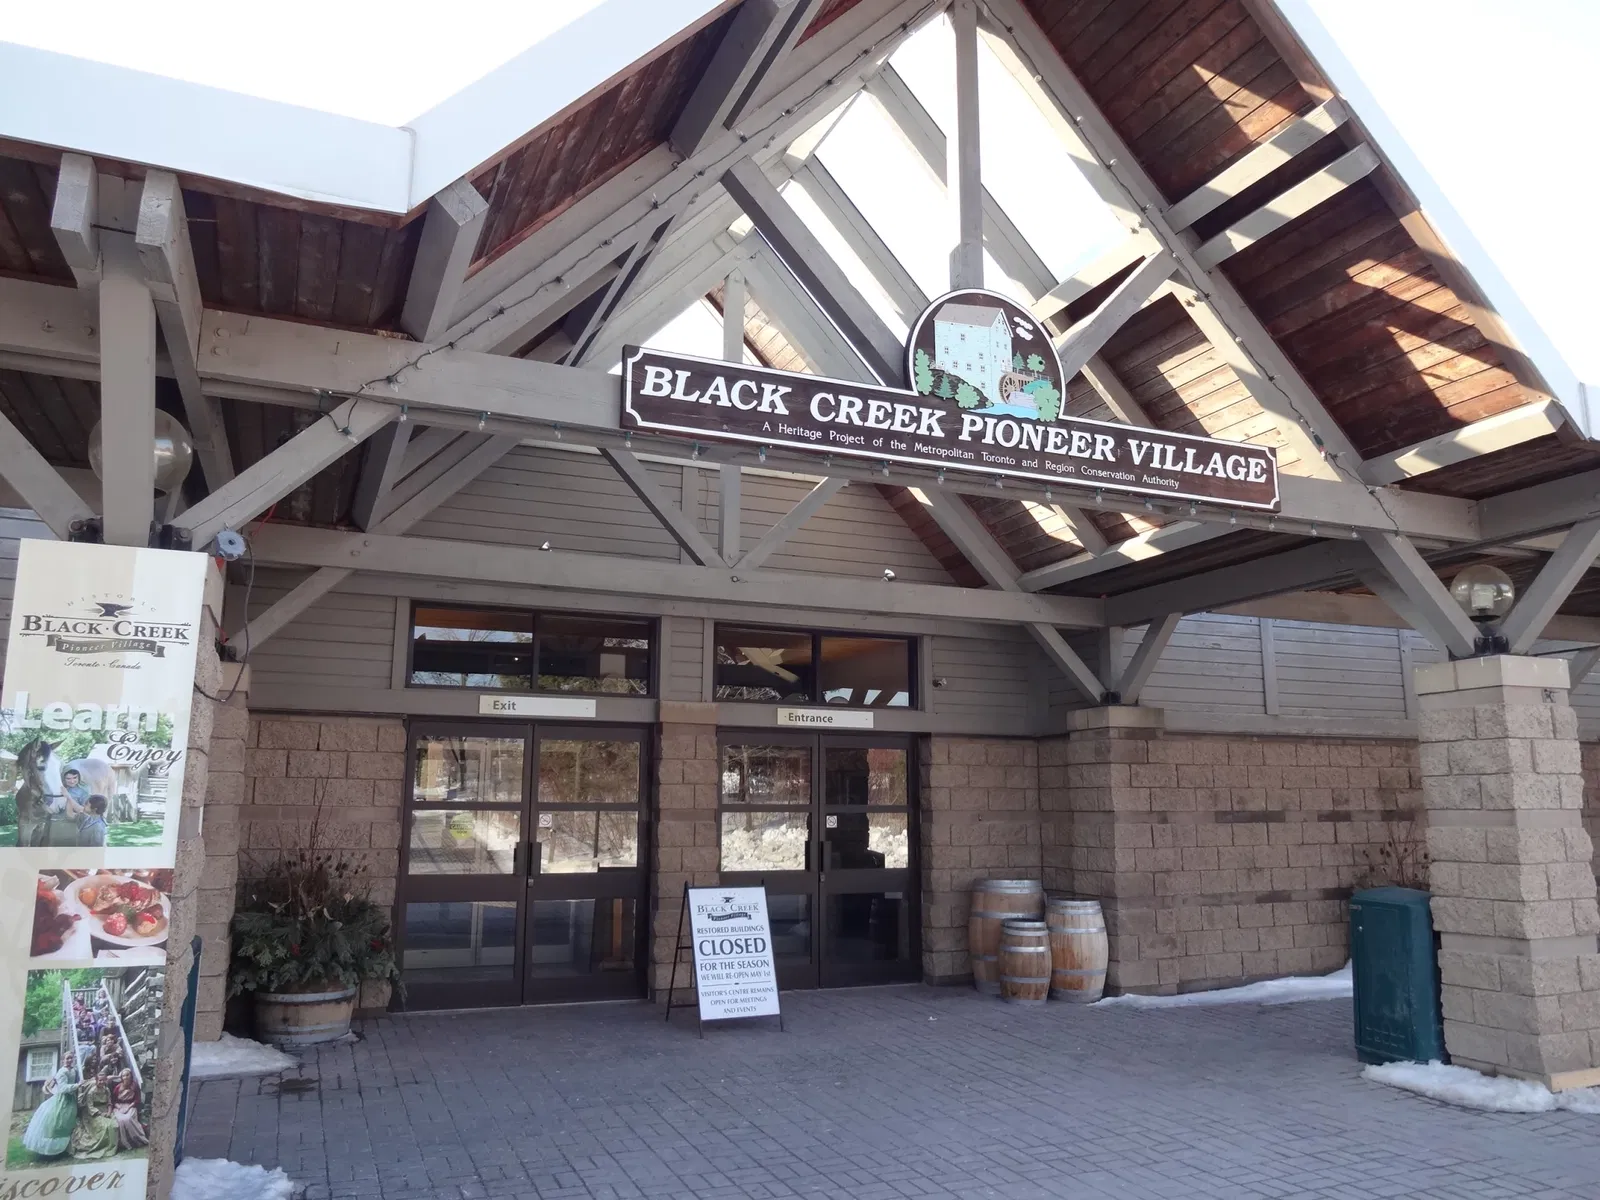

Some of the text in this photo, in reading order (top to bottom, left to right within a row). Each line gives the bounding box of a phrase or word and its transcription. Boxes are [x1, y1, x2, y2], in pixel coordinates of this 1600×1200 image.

[640, 365, 1267, 483] BLACK CREEK PIONEER VILLAGE
[762, 421, 1180, 490] A Heritage Project of the Metropolitan Toronto and Region Conservation Authority
[21, 614, 190, 641] BLACK CREEK
[62, 639, 152, 653] Pioneer Village
[63, 656, 142, 671] Toronto Canada
[14, 690, 159, 732] Learn
[492, 700, 517, 711] Exit
[788, 712, 833, 724] Entrance
[107, 730, 182, 774] Enjoy
[697, 903, 759, 913] BLACK CREEK
[696, 924, 765, 935] RESTORED BUILDINGS
[699, 937, 766, 956] CLOSED
[700, 959, 770, 971] FOR THE SEASON
[725, 971, 749, 980] RE-OPEN
[750, 970, 762, 978] MAY
[728, 988, 750, 996] CENTRE
[750, 987, 774, 995] REMAINS
[727, 997, 739, 1005] FOR
[737, 1005, 757, 1013] EVENTS
[0, 1170, 125, 1200] iscover
